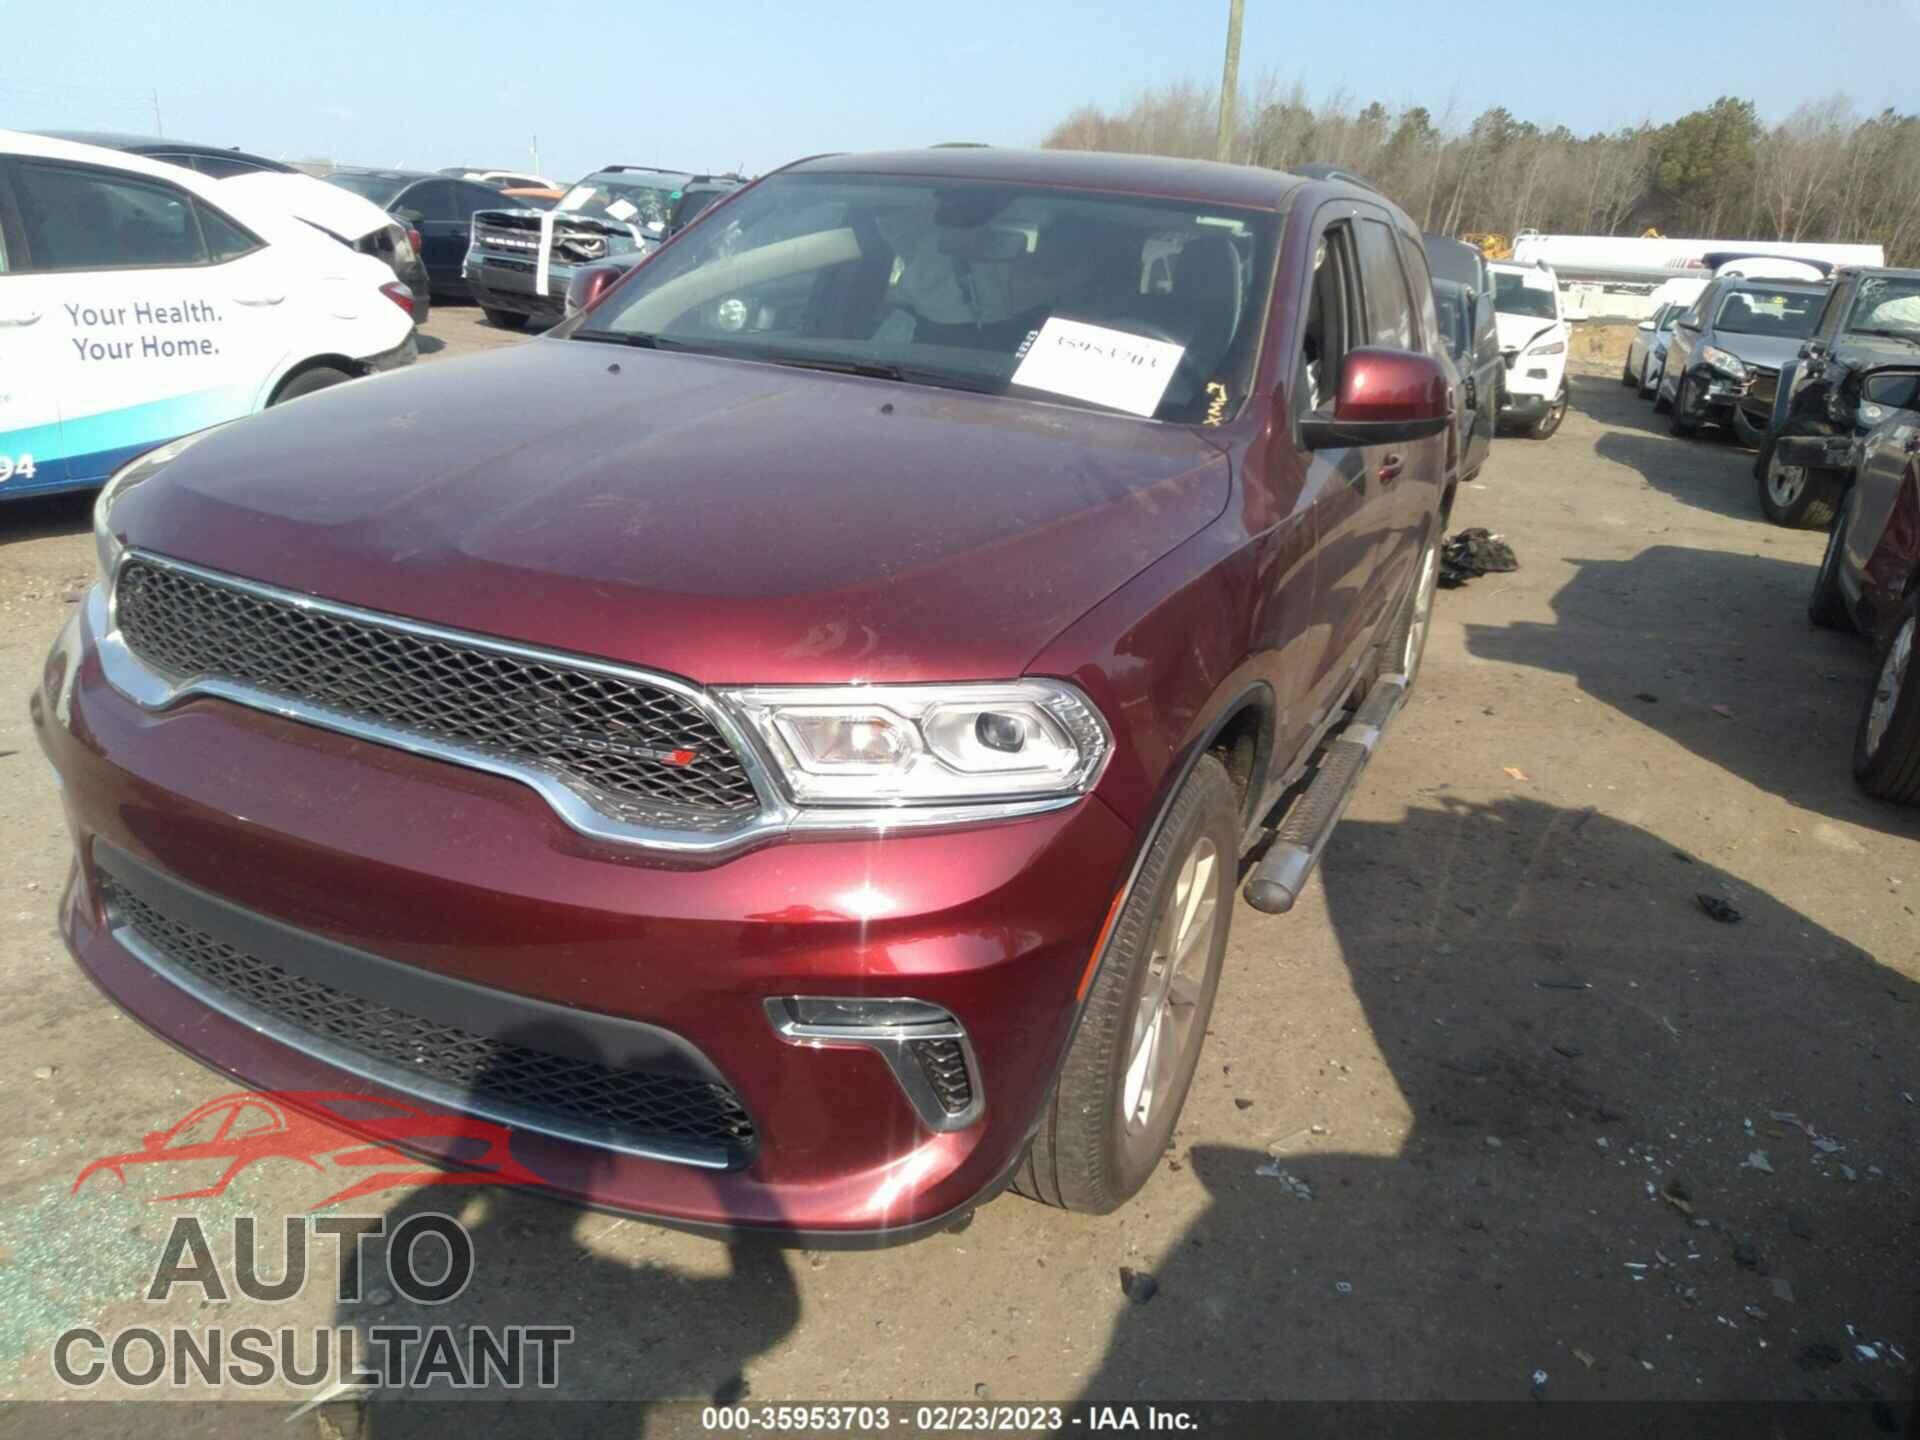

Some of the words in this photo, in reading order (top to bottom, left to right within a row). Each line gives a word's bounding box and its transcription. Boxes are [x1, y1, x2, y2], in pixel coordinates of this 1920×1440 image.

[64, 304, 127, 327] Your
[134, 299, 223, 325] Health.
[72, 338, 134, 361] Your
[141, 335, 220, 358] Home.
